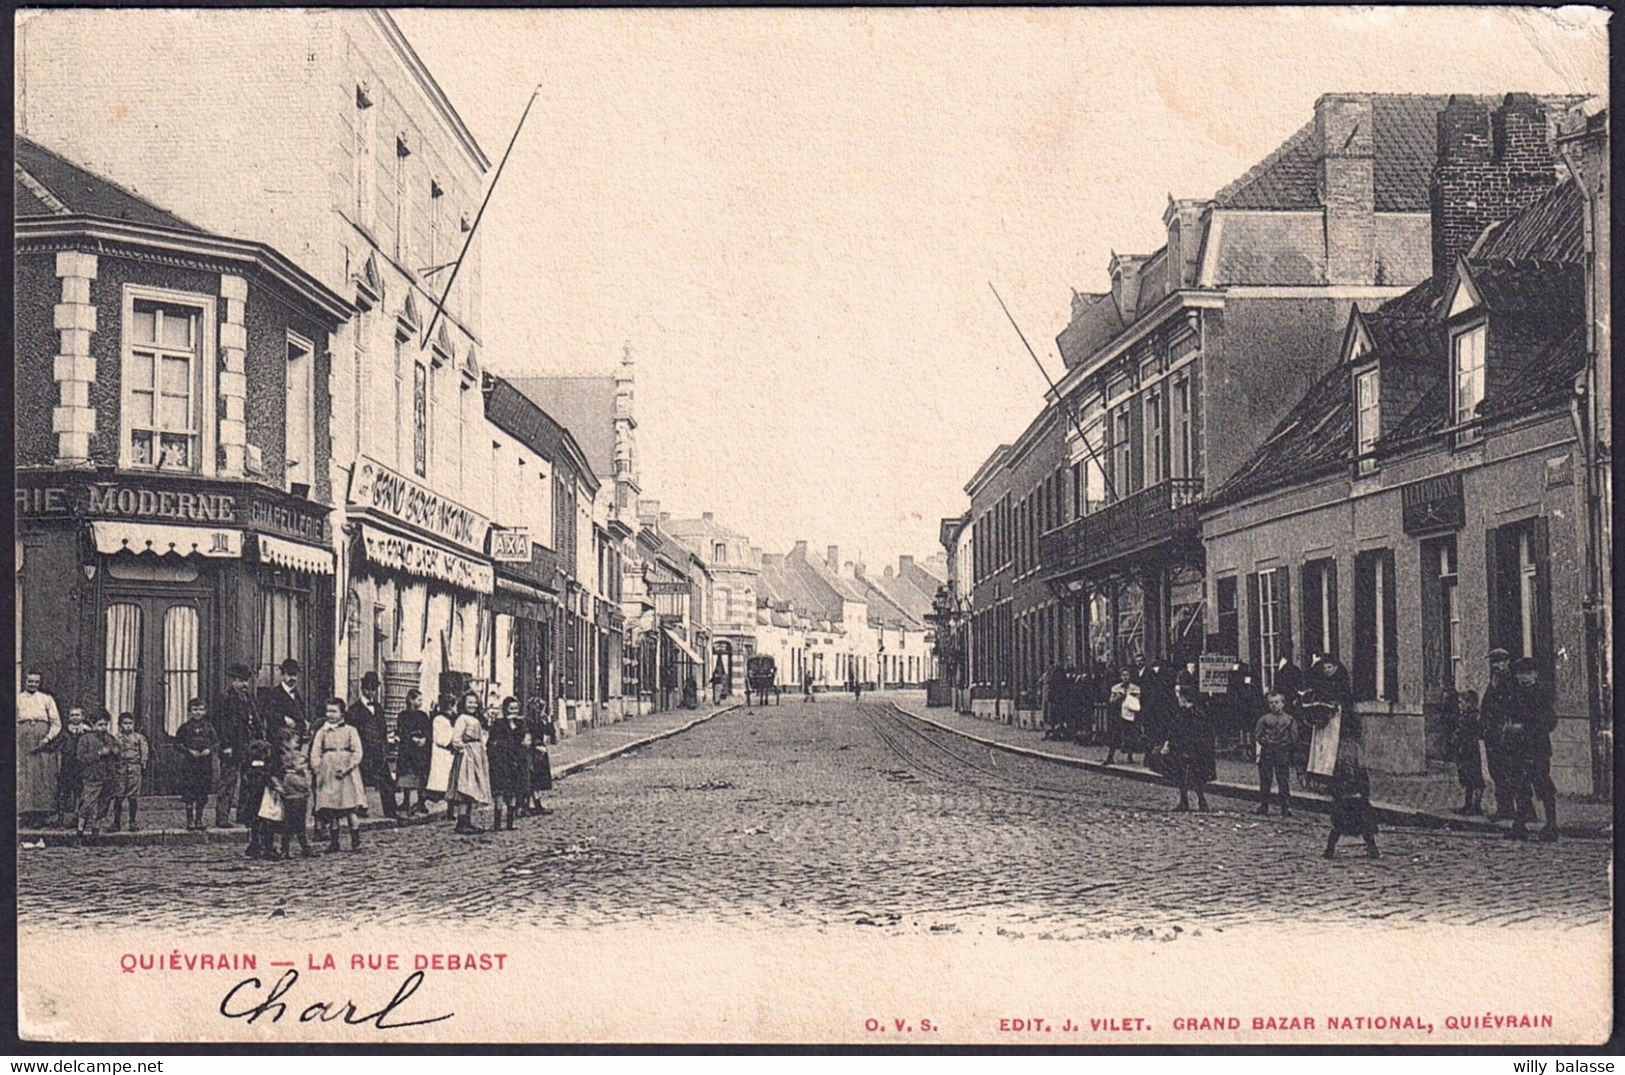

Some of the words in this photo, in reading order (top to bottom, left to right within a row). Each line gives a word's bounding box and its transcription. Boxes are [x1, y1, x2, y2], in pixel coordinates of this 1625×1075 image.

[16, 487, 66, 512] RIE
[88, 485, 236, 522] MODERNE
[251, 500, 321, 541] CHAPELLERIE
[494, 535, 528, 555] AXA
